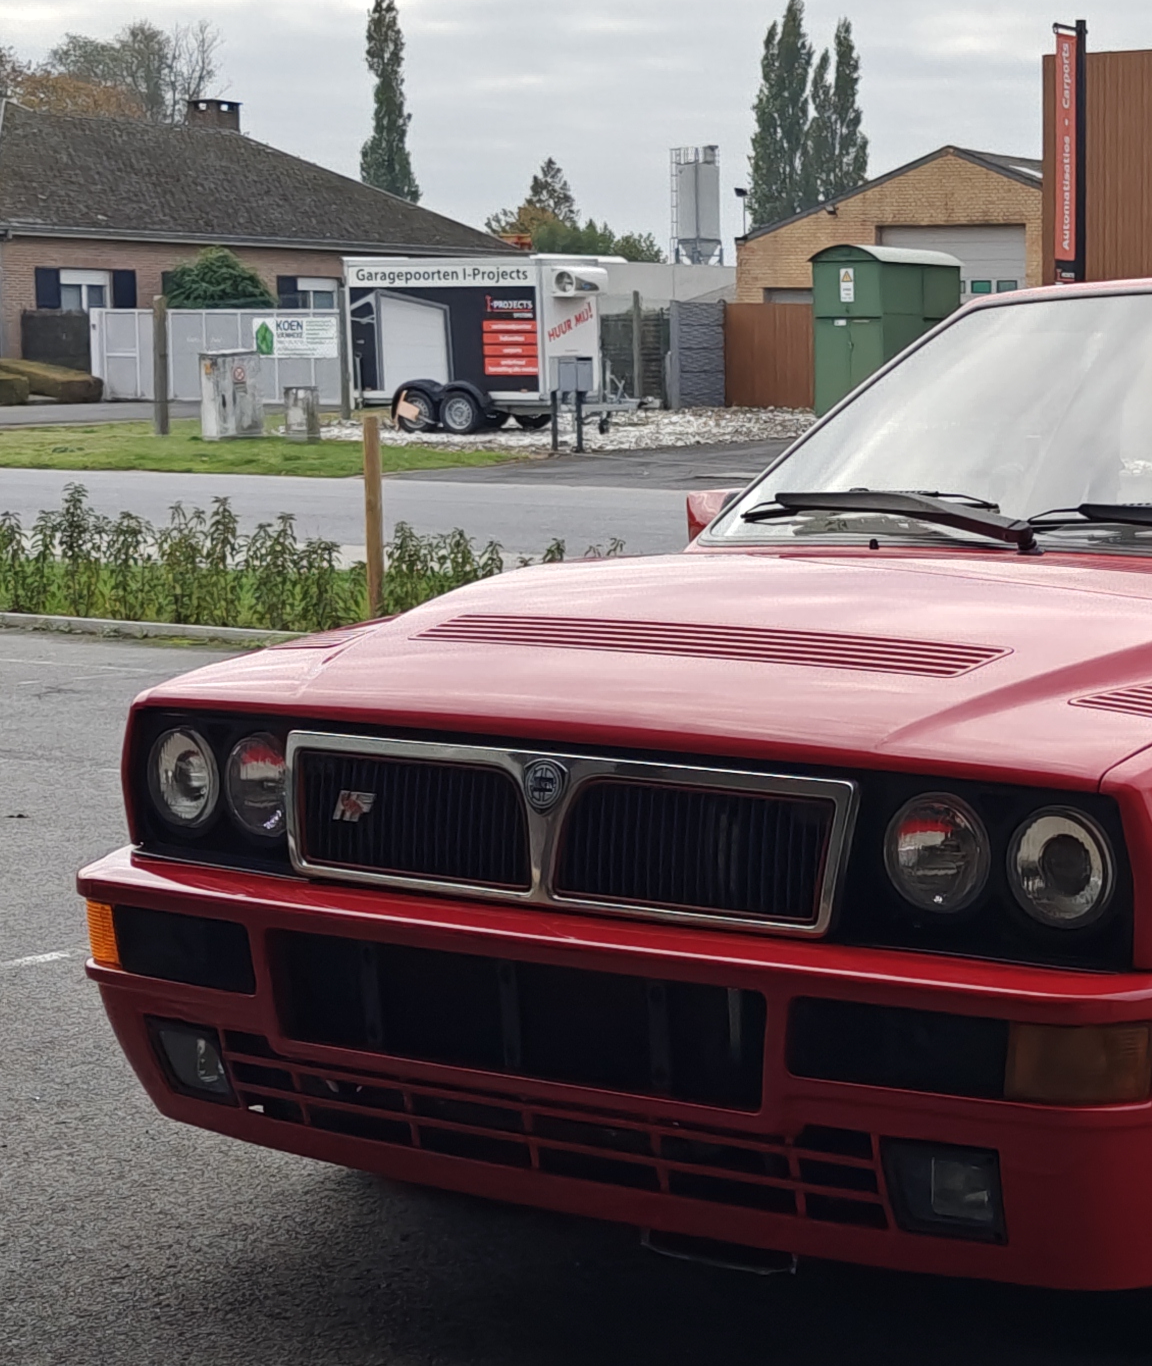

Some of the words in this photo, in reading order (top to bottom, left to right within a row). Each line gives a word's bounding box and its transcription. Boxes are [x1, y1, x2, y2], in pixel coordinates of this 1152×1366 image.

[1061, 43, 1070, 109] Carports
[356, 268, 459, 284] Garagepoorten
[463, 267, 528, 283] I-Projects
[485, 295, 533, 312] I-PROJECTS
[276, 320, 304, 331] KOEN
[547, 318, 573, 342] HUUR
[574, 301, 593, 327] MIJ!
